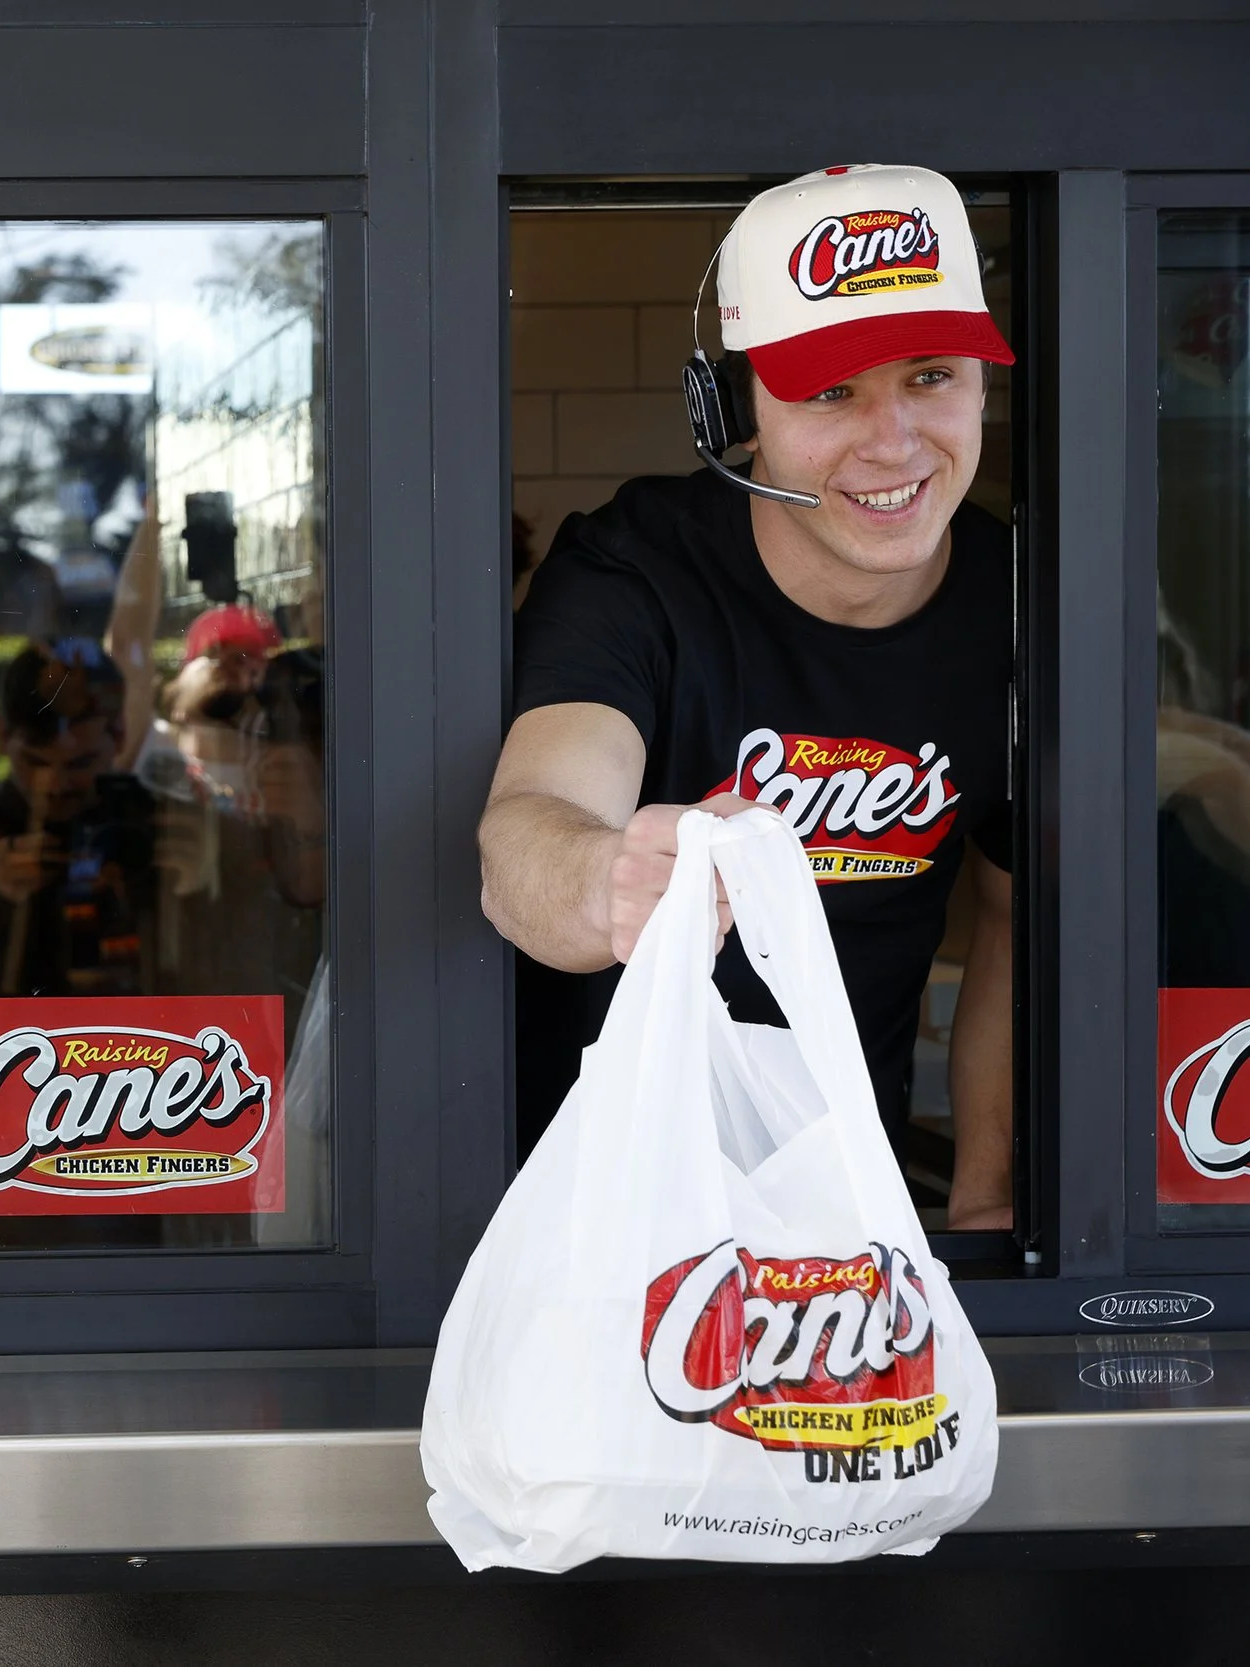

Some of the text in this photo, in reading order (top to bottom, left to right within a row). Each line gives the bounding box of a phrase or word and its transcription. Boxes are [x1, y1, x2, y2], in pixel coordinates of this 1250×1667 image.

[847, 212, 899, 232] Raising
[798, 207, 937, 296] Cane's
[847, 275, 896, 293] CHICKEN
[723, 306, 741, 320] LOVE
[789, 739, 886, 771] Raising
[840, 856, 917, 874] FINGERS
[61, 1040, 169, 1068] Raising
[55, 1156, 230, 1174] CHICKEN FINGERS
[746, 1406, 853, 1432] CHICKEN
[804, 1446, 881, 1484] ONE
